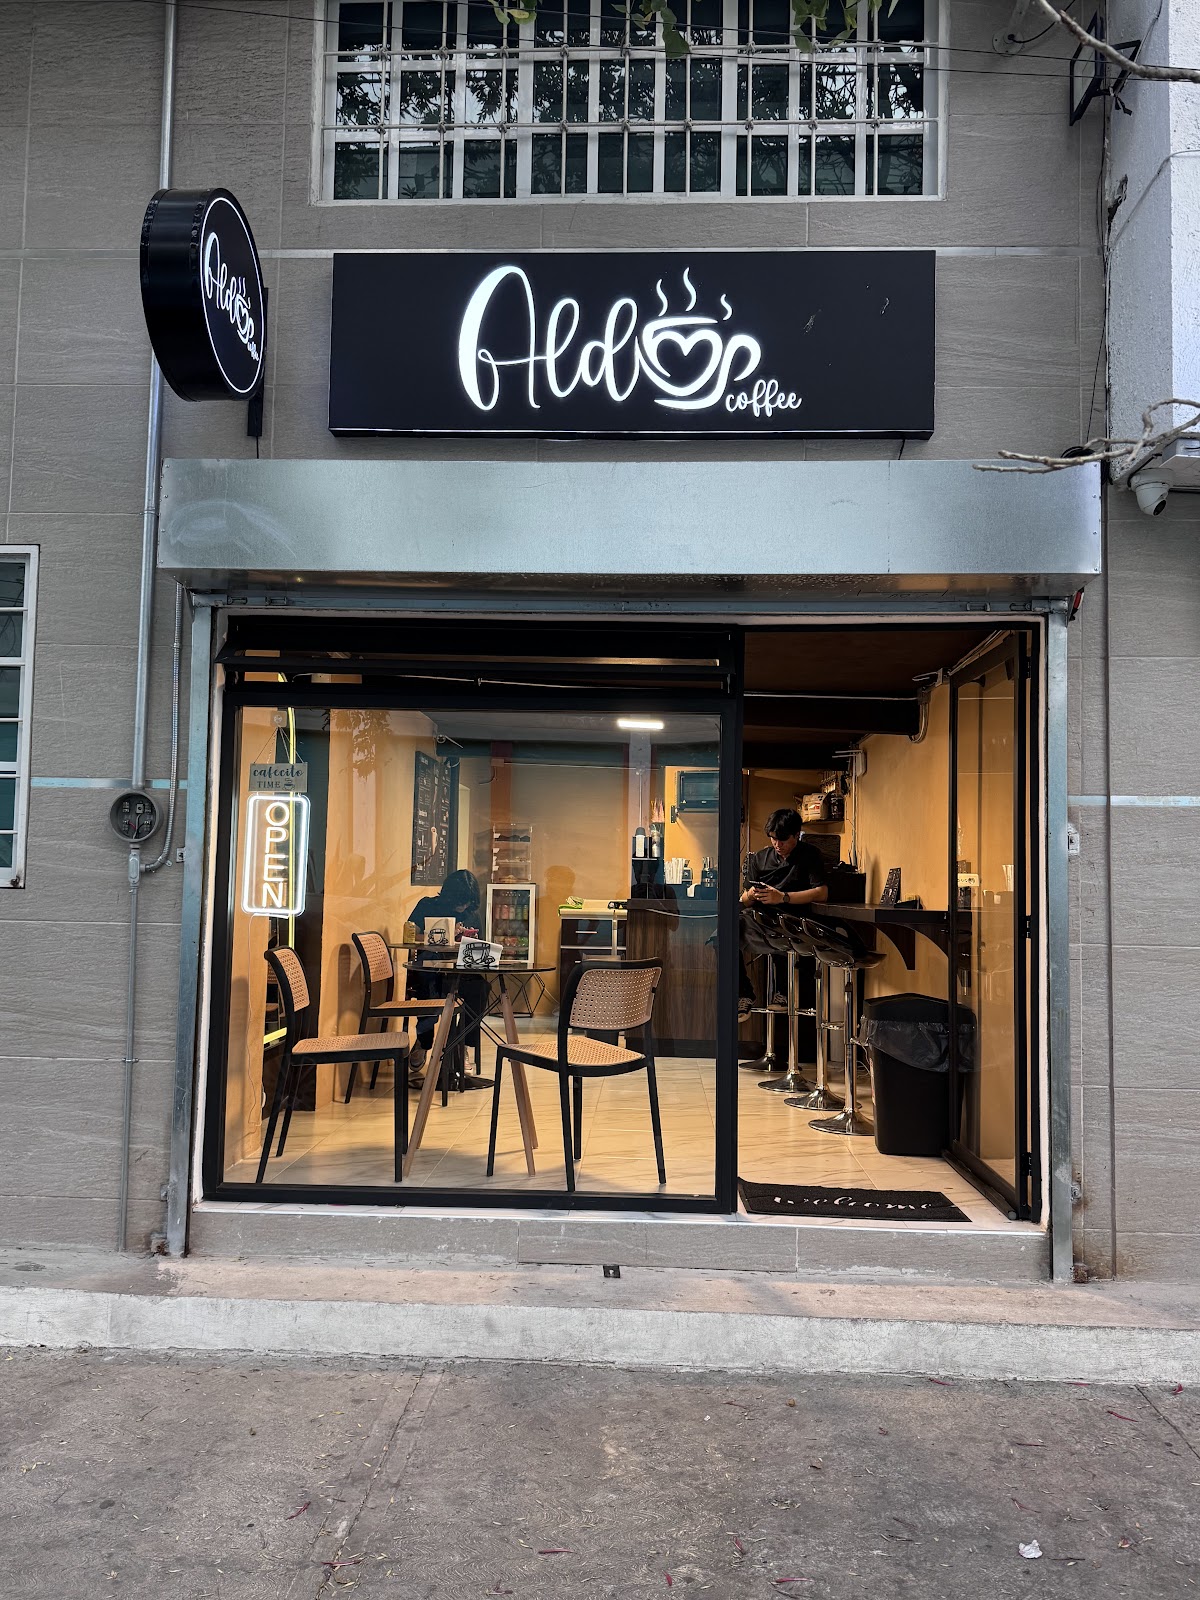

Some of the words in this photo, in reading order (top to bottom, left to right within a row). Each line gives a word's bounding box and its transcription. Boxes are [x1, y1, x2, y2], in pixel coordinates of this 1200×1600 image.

[725, 379, 803, 418] coffee
[253, 764, 305, 779] cafecito
[256, 780, 281, 789] TIME
[262, 801, 291, 909] OPEN
